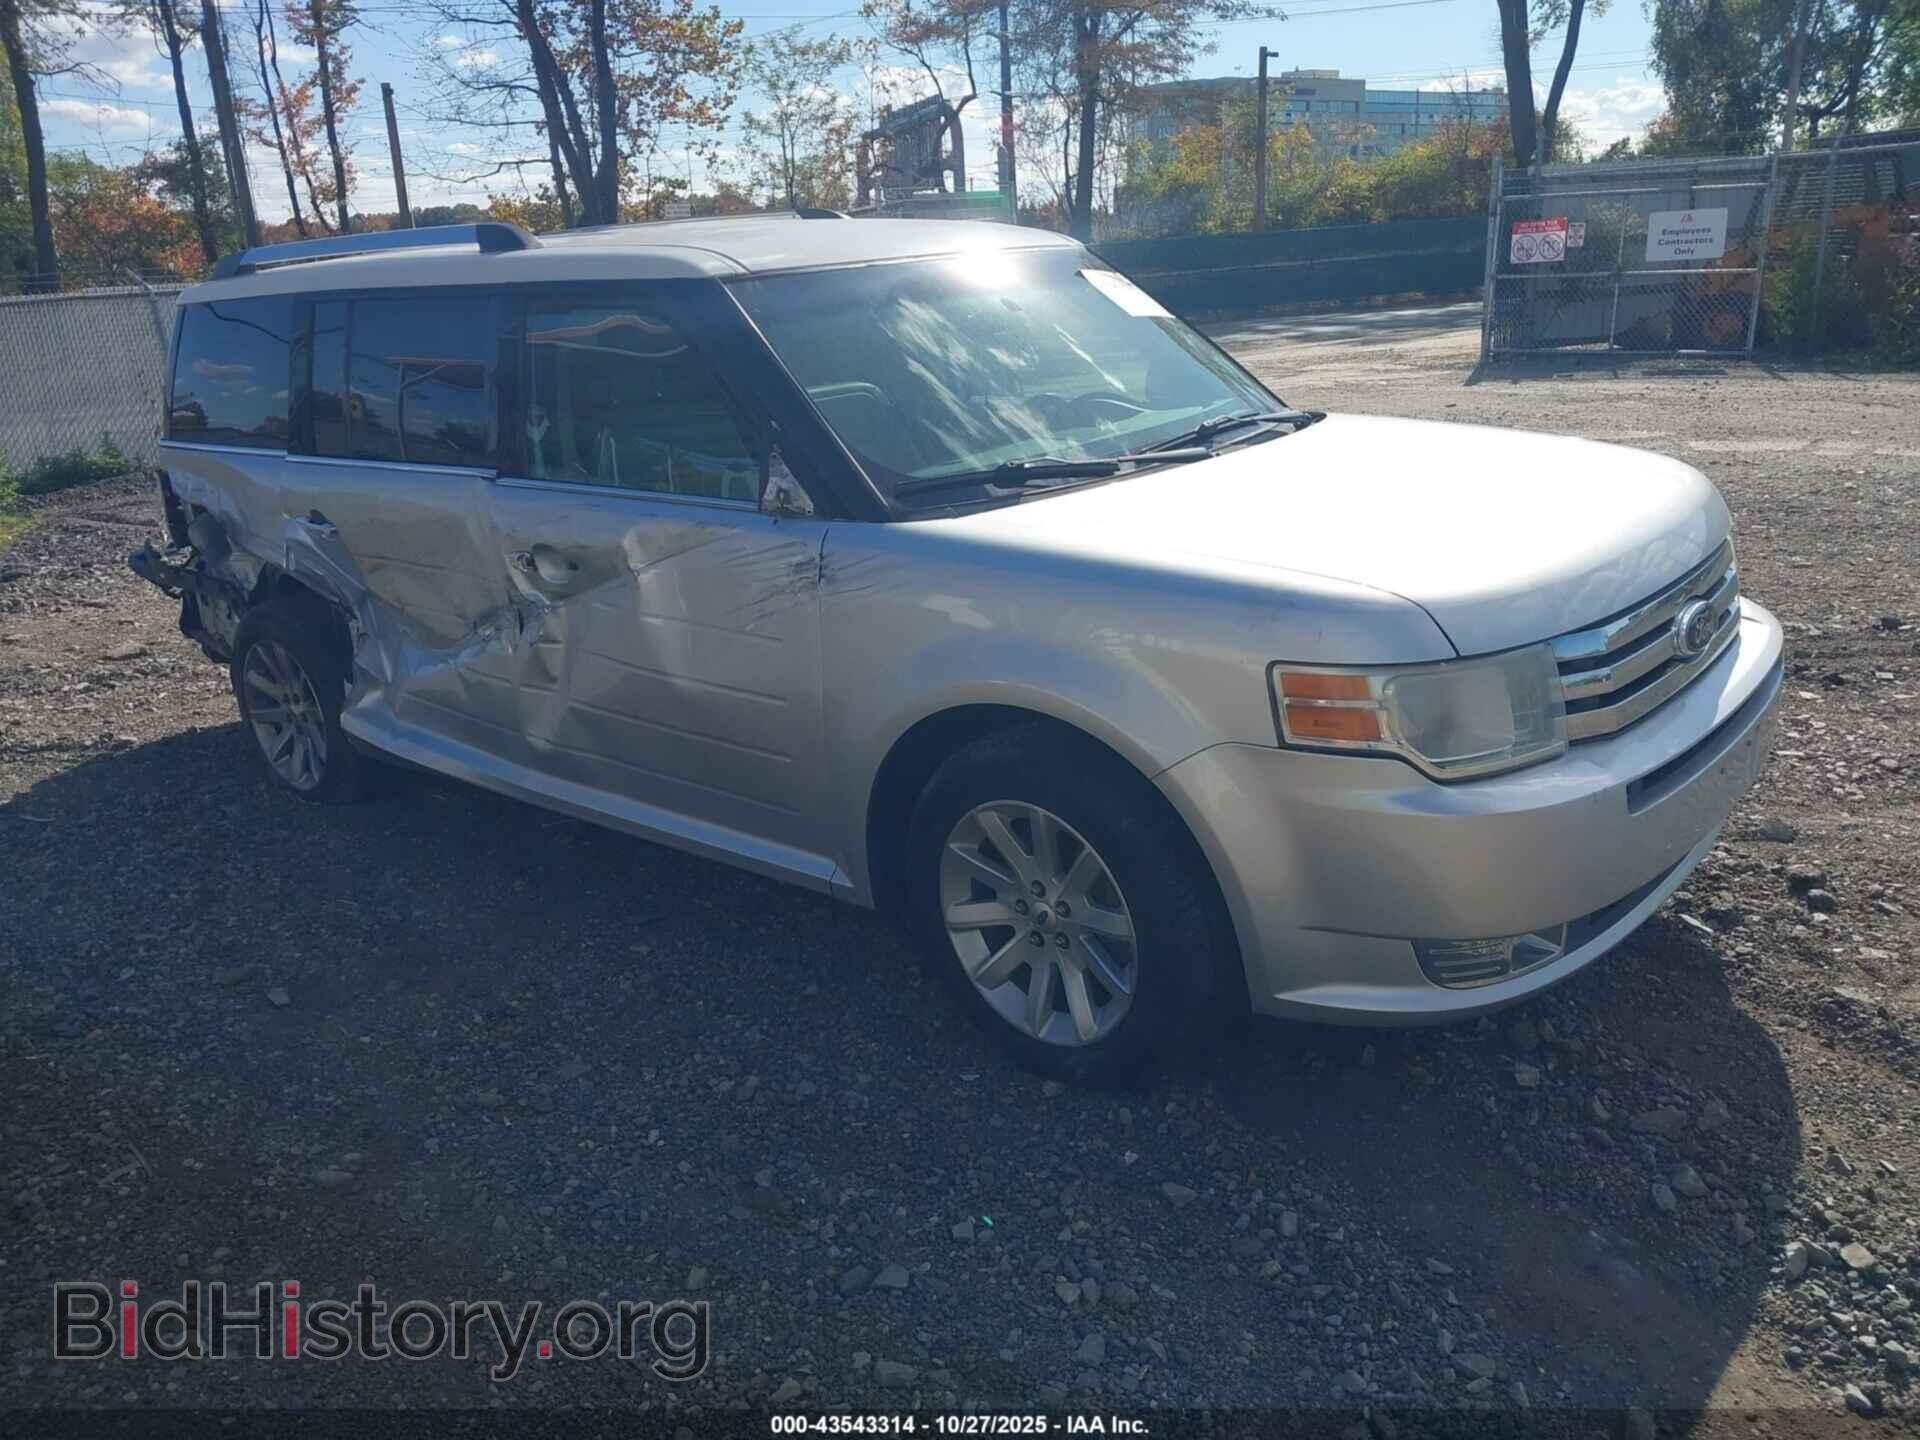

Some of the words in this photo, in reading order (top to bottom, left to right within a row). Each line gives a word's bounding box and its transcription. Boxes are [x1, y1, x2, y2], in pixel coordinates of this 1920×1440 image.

[1661, 226, 1712, 237] Employees
[1657, 237, 1713, 247] Contractors
[1673, 247, 1695, 257] Only
